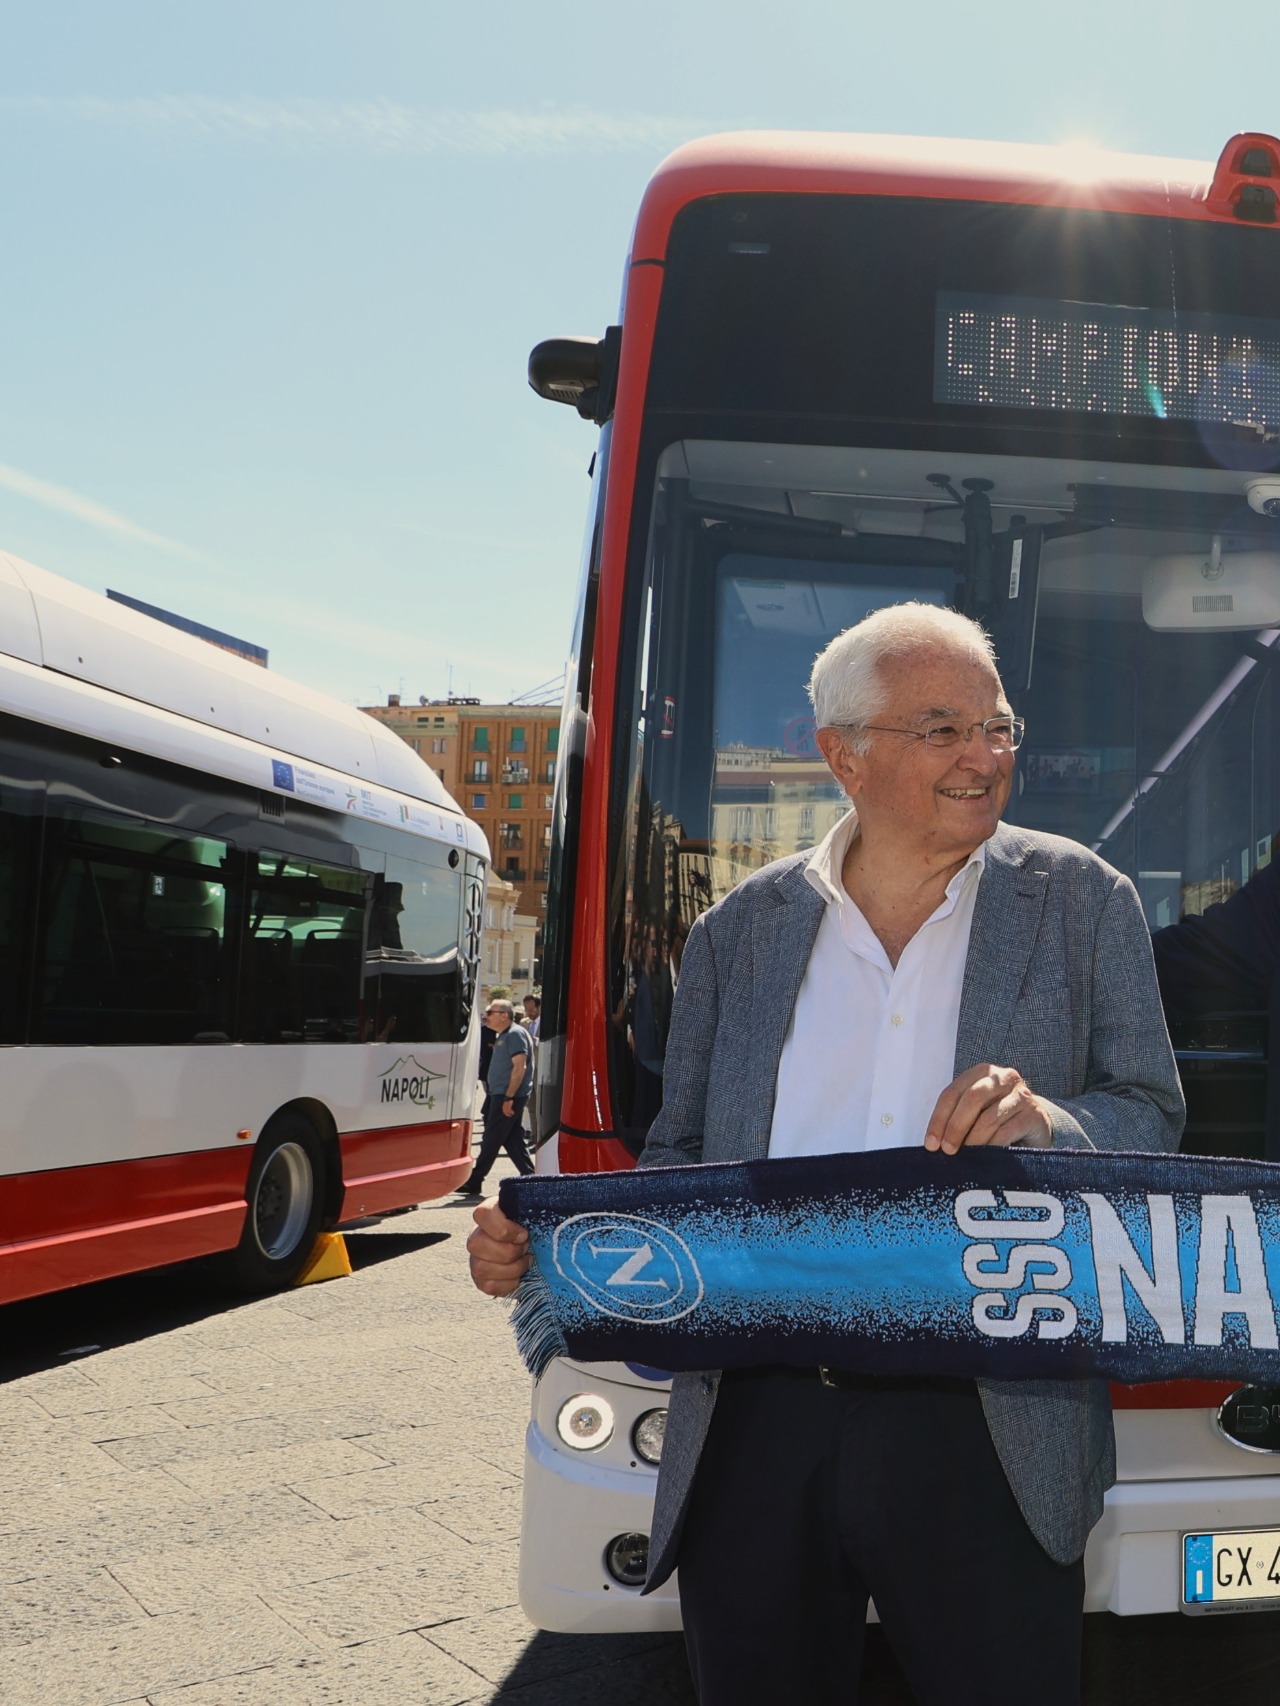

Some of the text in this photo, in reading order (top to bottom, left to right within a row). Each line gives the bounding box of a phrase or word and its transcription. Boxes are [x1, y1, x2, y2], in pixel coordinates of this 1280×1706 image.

[381, 1076, 430, 1103] NAPOLI
[954, 1189, 1079, 1341] SSC
[1217, 1546, 1253, 1587] GX
